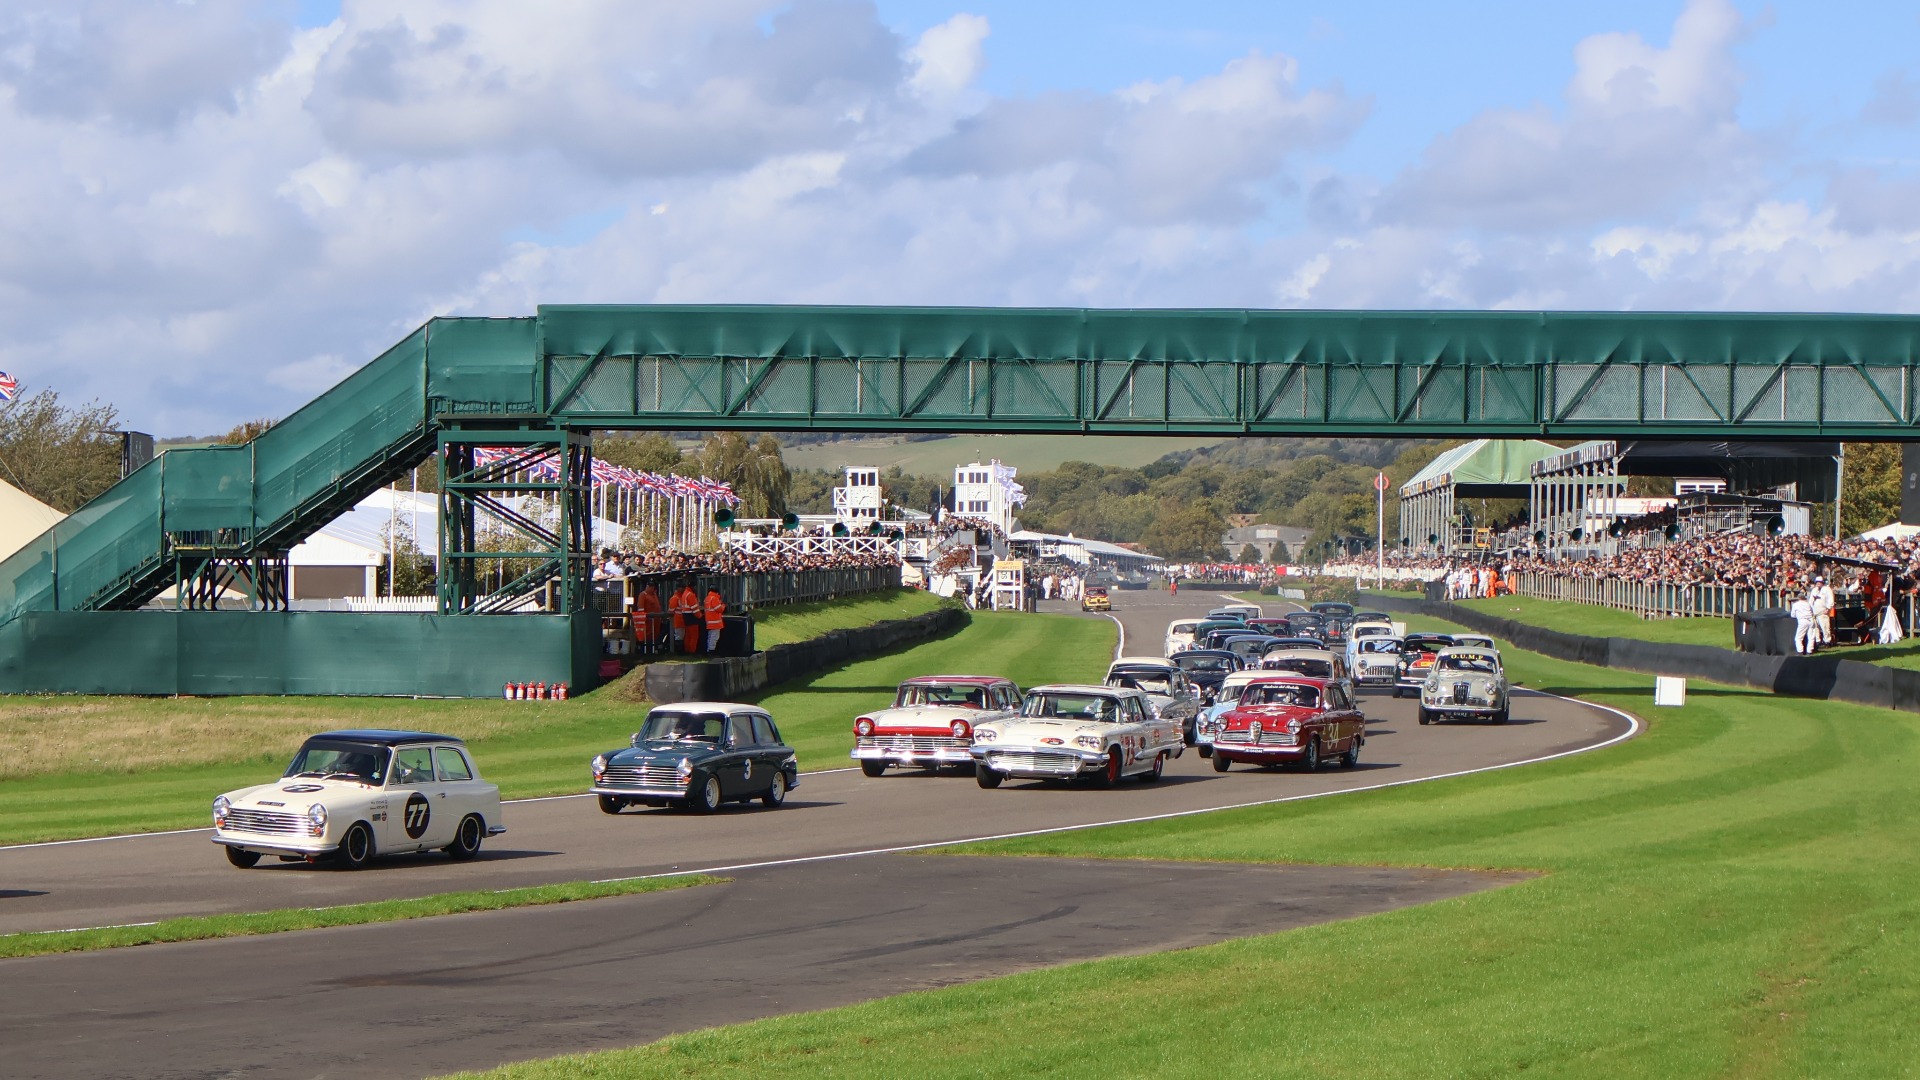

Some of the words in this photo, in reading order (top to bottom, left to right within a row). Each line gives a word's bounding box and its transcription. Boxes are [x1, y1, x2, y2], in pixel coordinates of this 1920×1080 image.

[1327, 721, 1339, 750] 34
[744, 758, 752, 780] 3
[406, 803, 428, 829] 77
